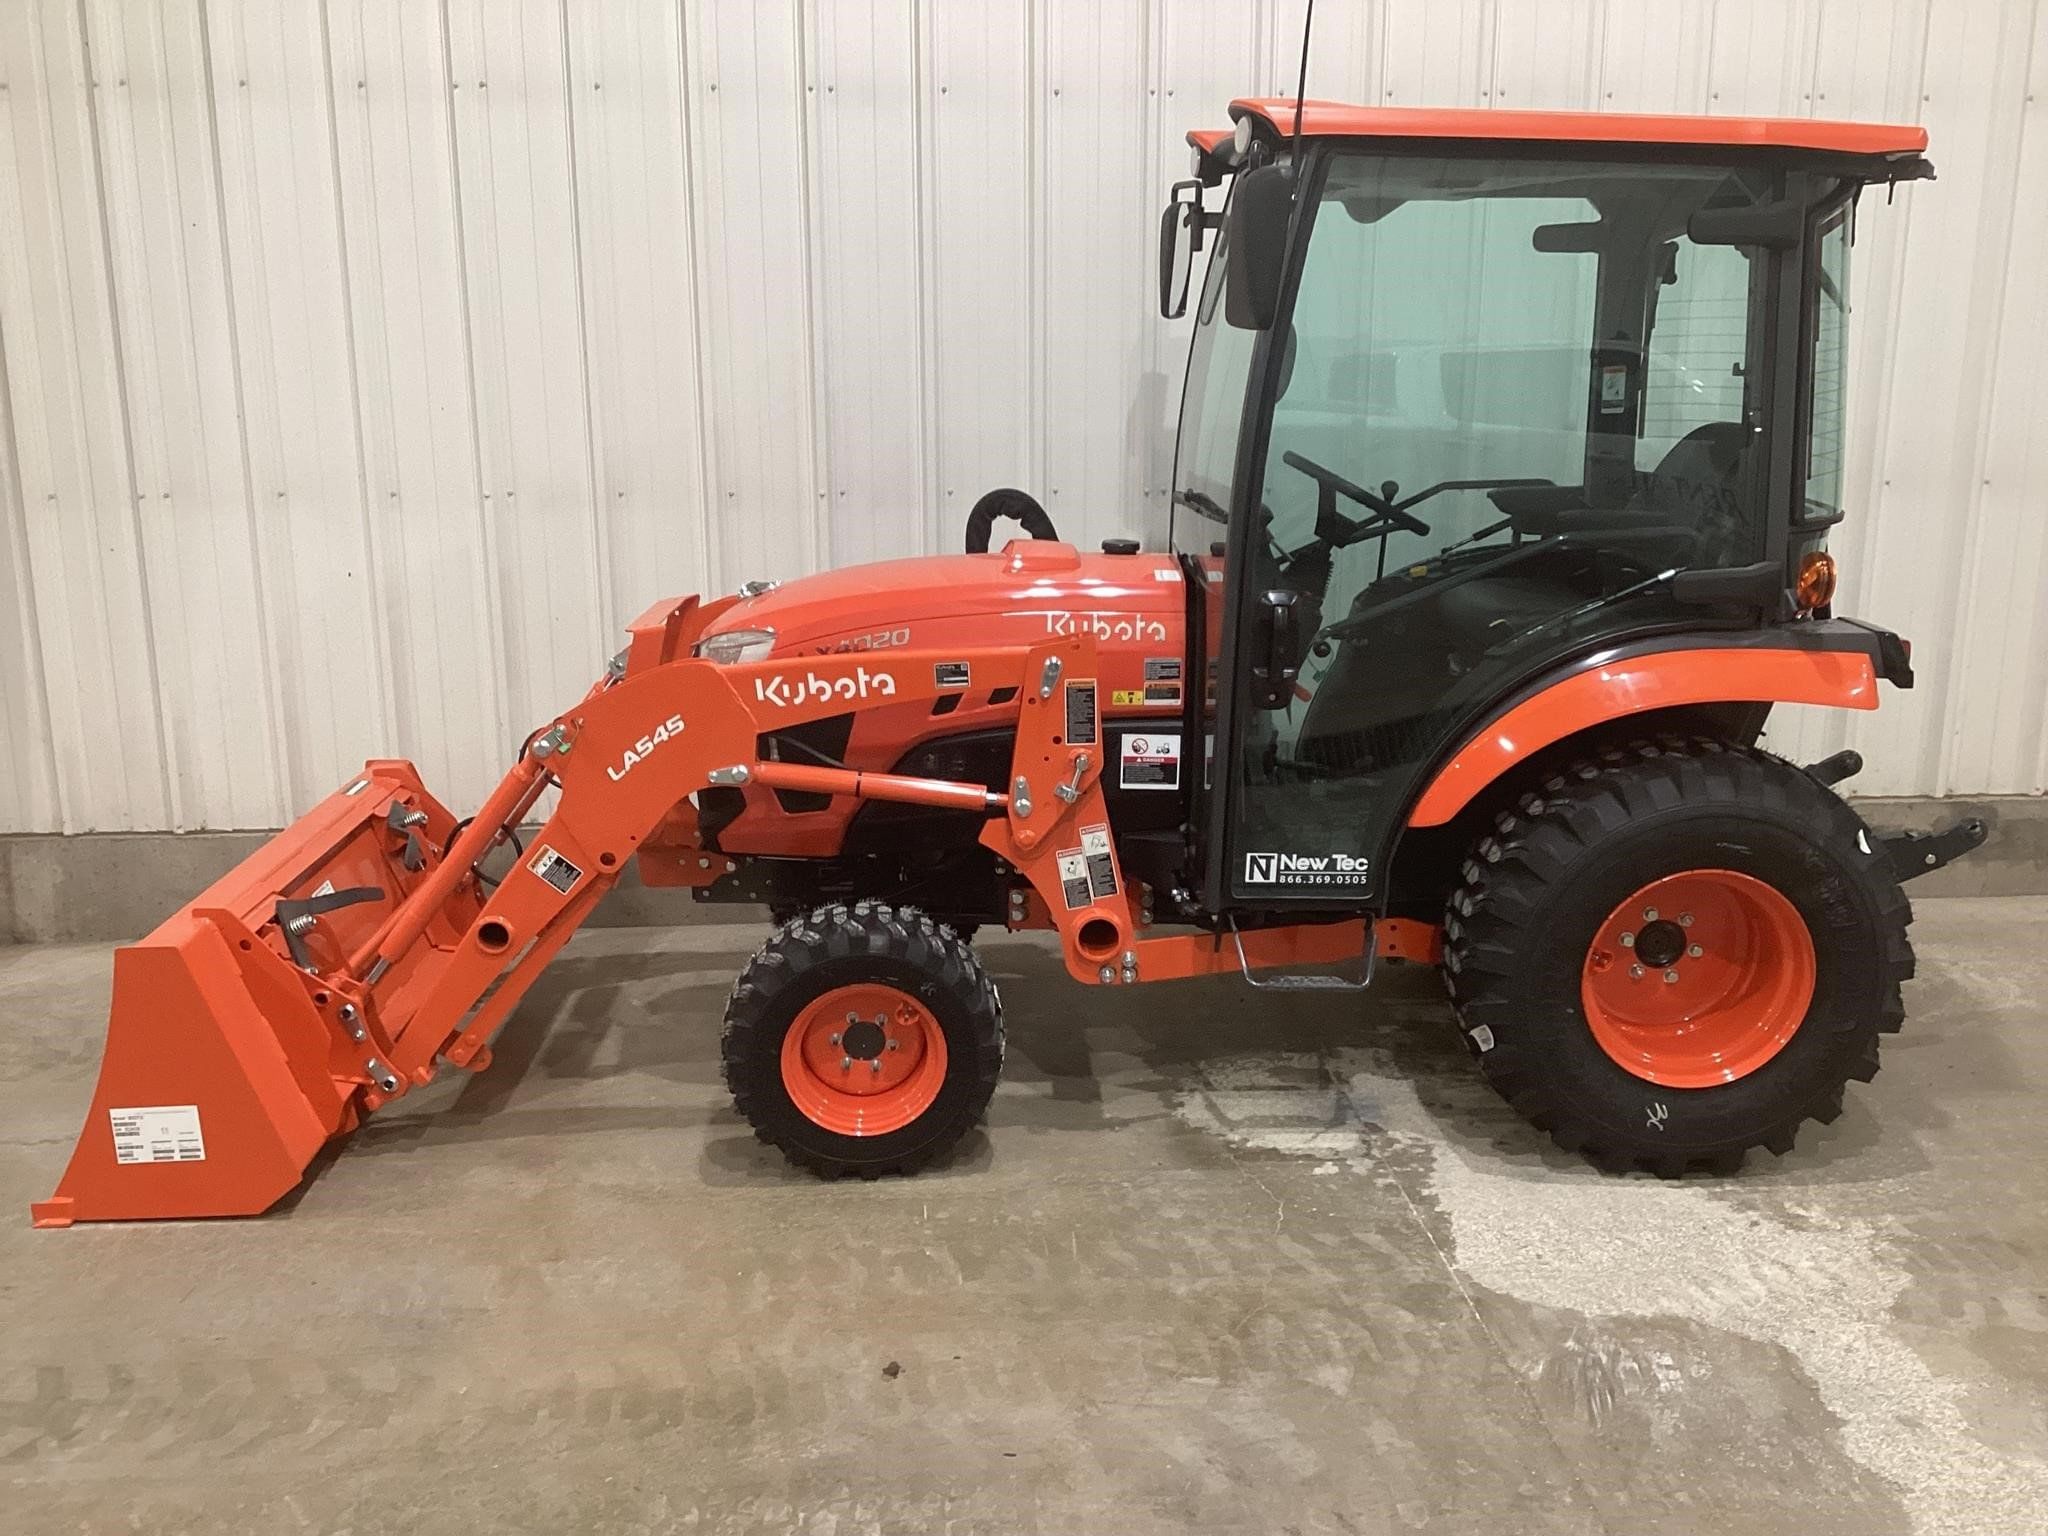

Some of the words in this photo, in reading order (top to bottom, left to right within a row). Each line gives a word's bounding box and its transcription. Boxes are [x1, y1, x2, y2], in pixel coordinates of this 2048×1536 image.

[1047, 612, 1166, 641] Kubota
[754, 666, 896, 708] Kubota
[606, 713, 685, 781] LA545
[1280, 853, 1329, 871] New
[1331, 853, 1369, 871] Tec
[1279, 874, 1367, 885] 866.369.0505
